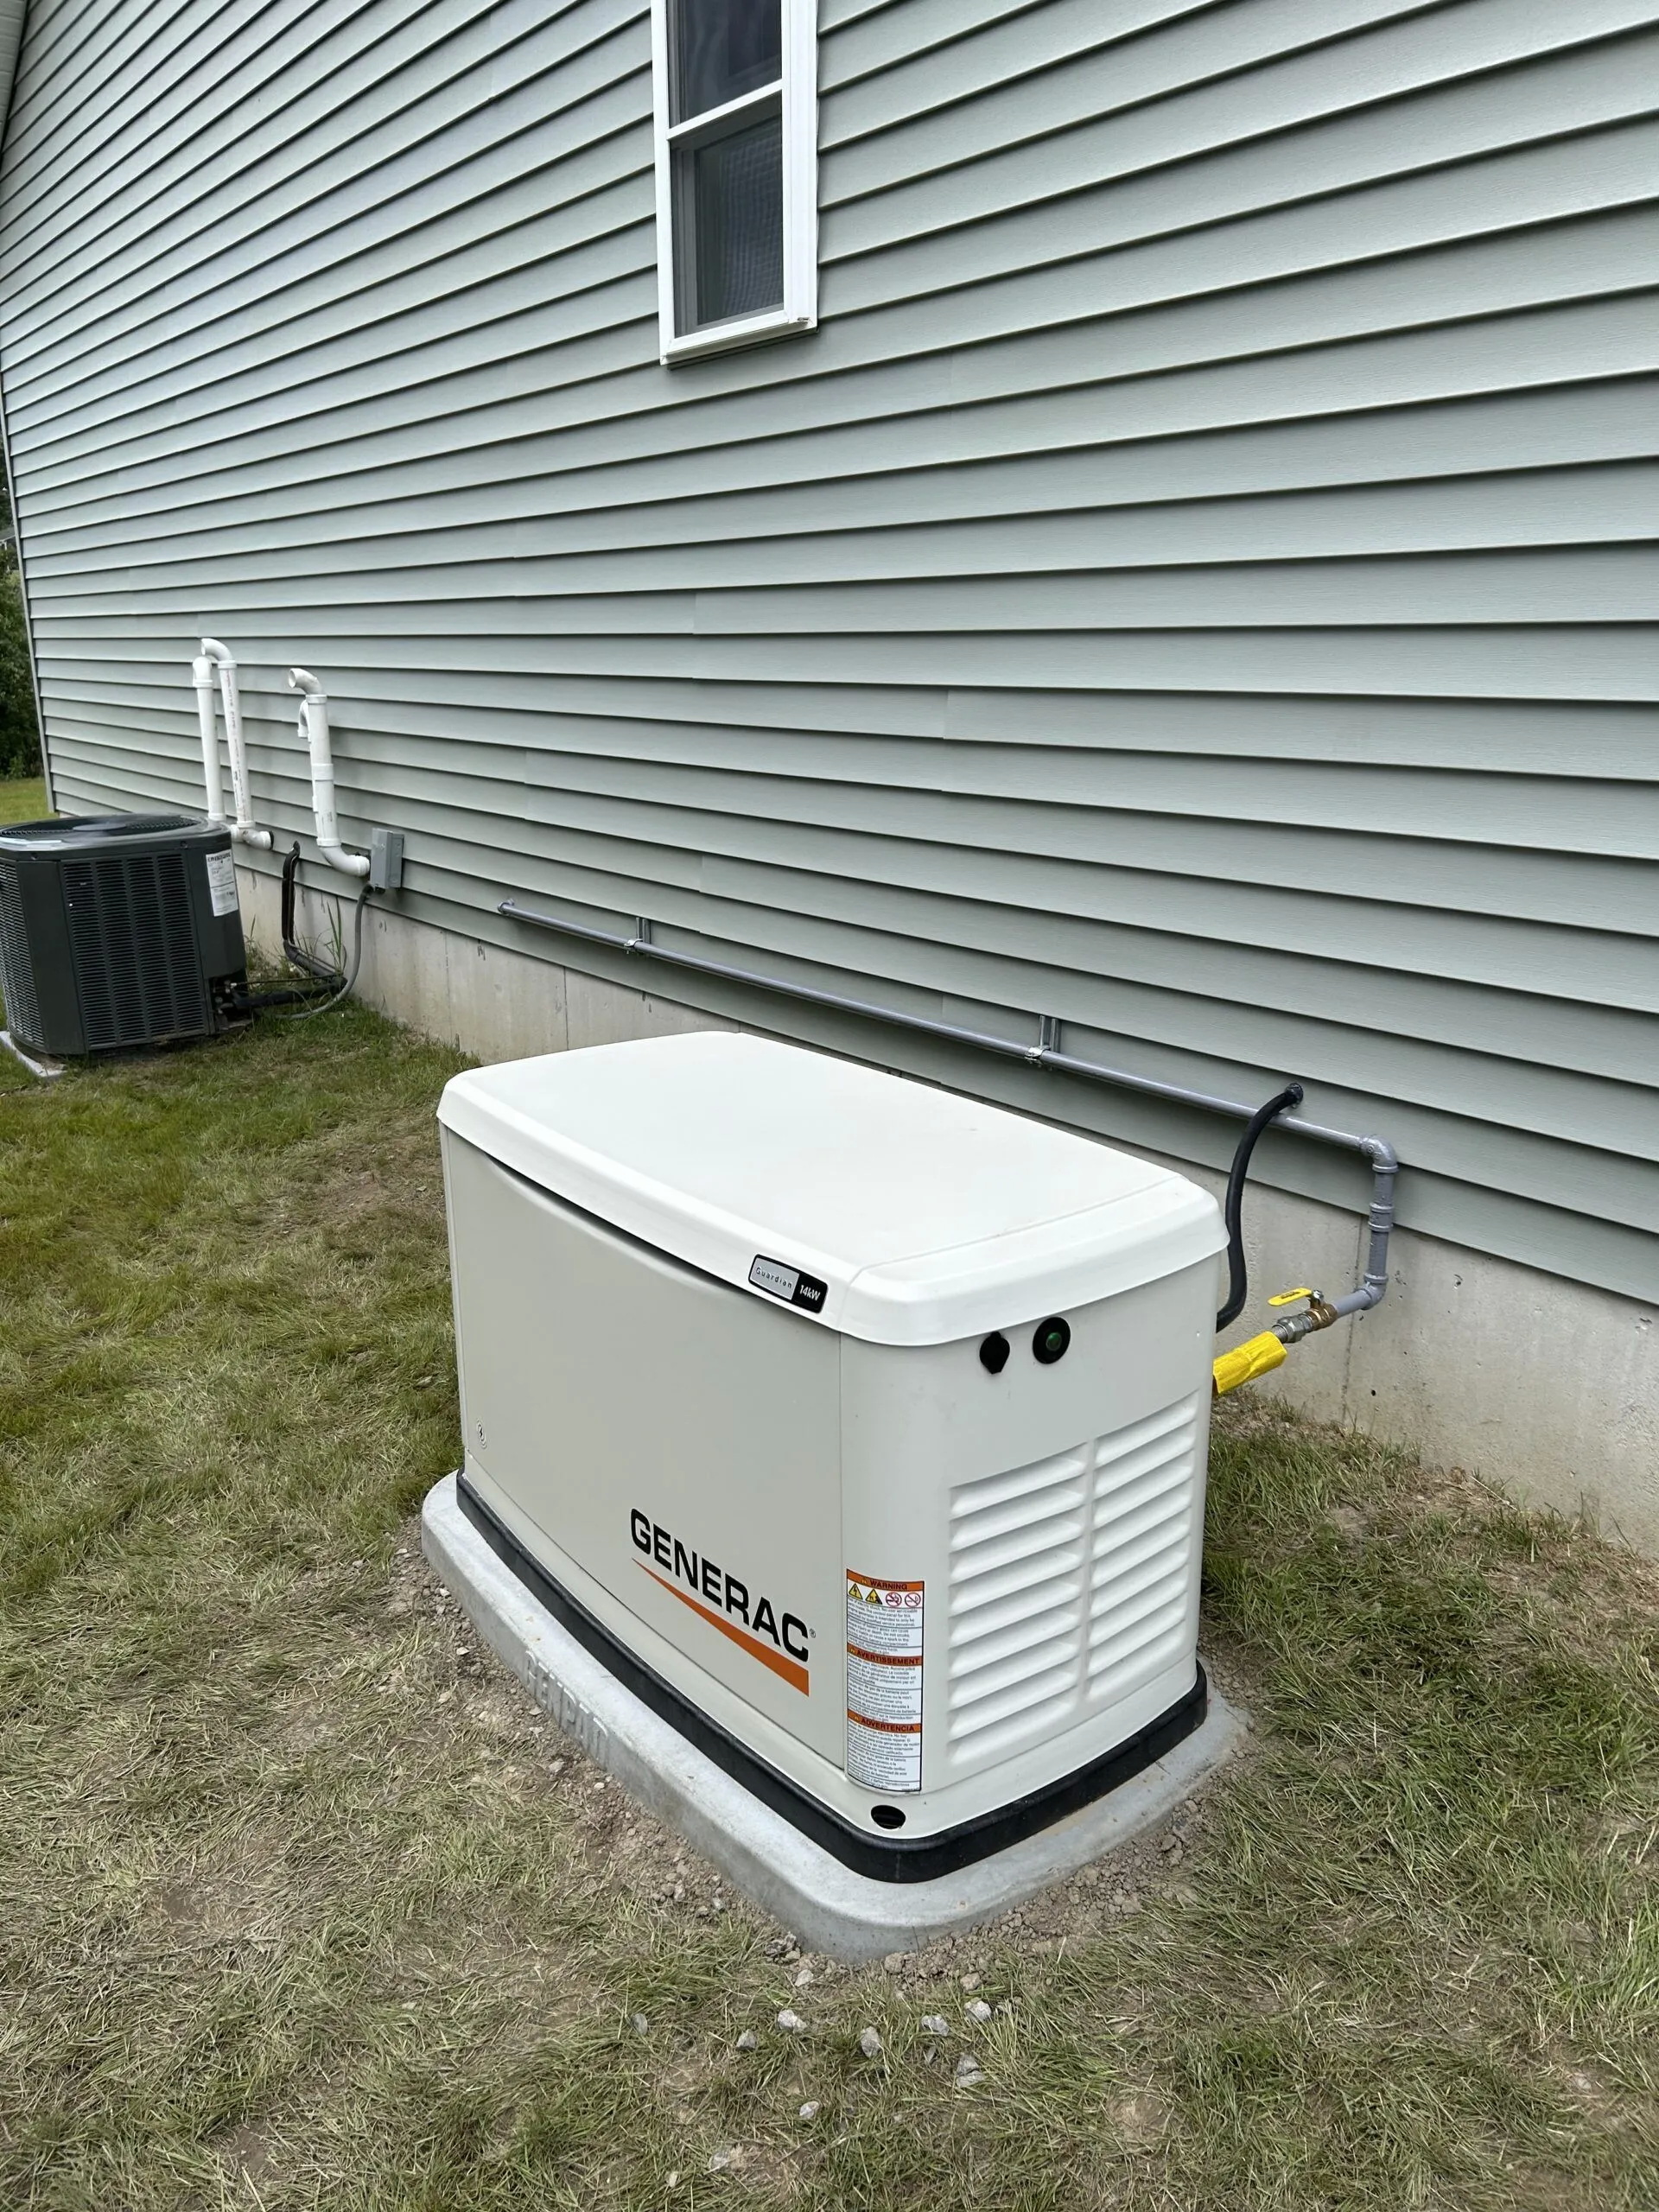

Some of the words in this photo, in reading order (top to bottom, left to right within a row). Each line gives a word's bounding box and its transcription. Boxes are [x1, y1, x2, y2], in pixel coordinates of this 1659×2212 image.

[756, 1267, 792, 1288] Guardian
[799, 1284, 821, 1301] 14kW
[631, 1508, 809, 1662] GENERAC
[870, 1580, 907, 1590] WARNING
[856, 1650, 920, 1664] AVERTISSEMENT
[861, 1718, 915, 1732] ADVERTENCIA
